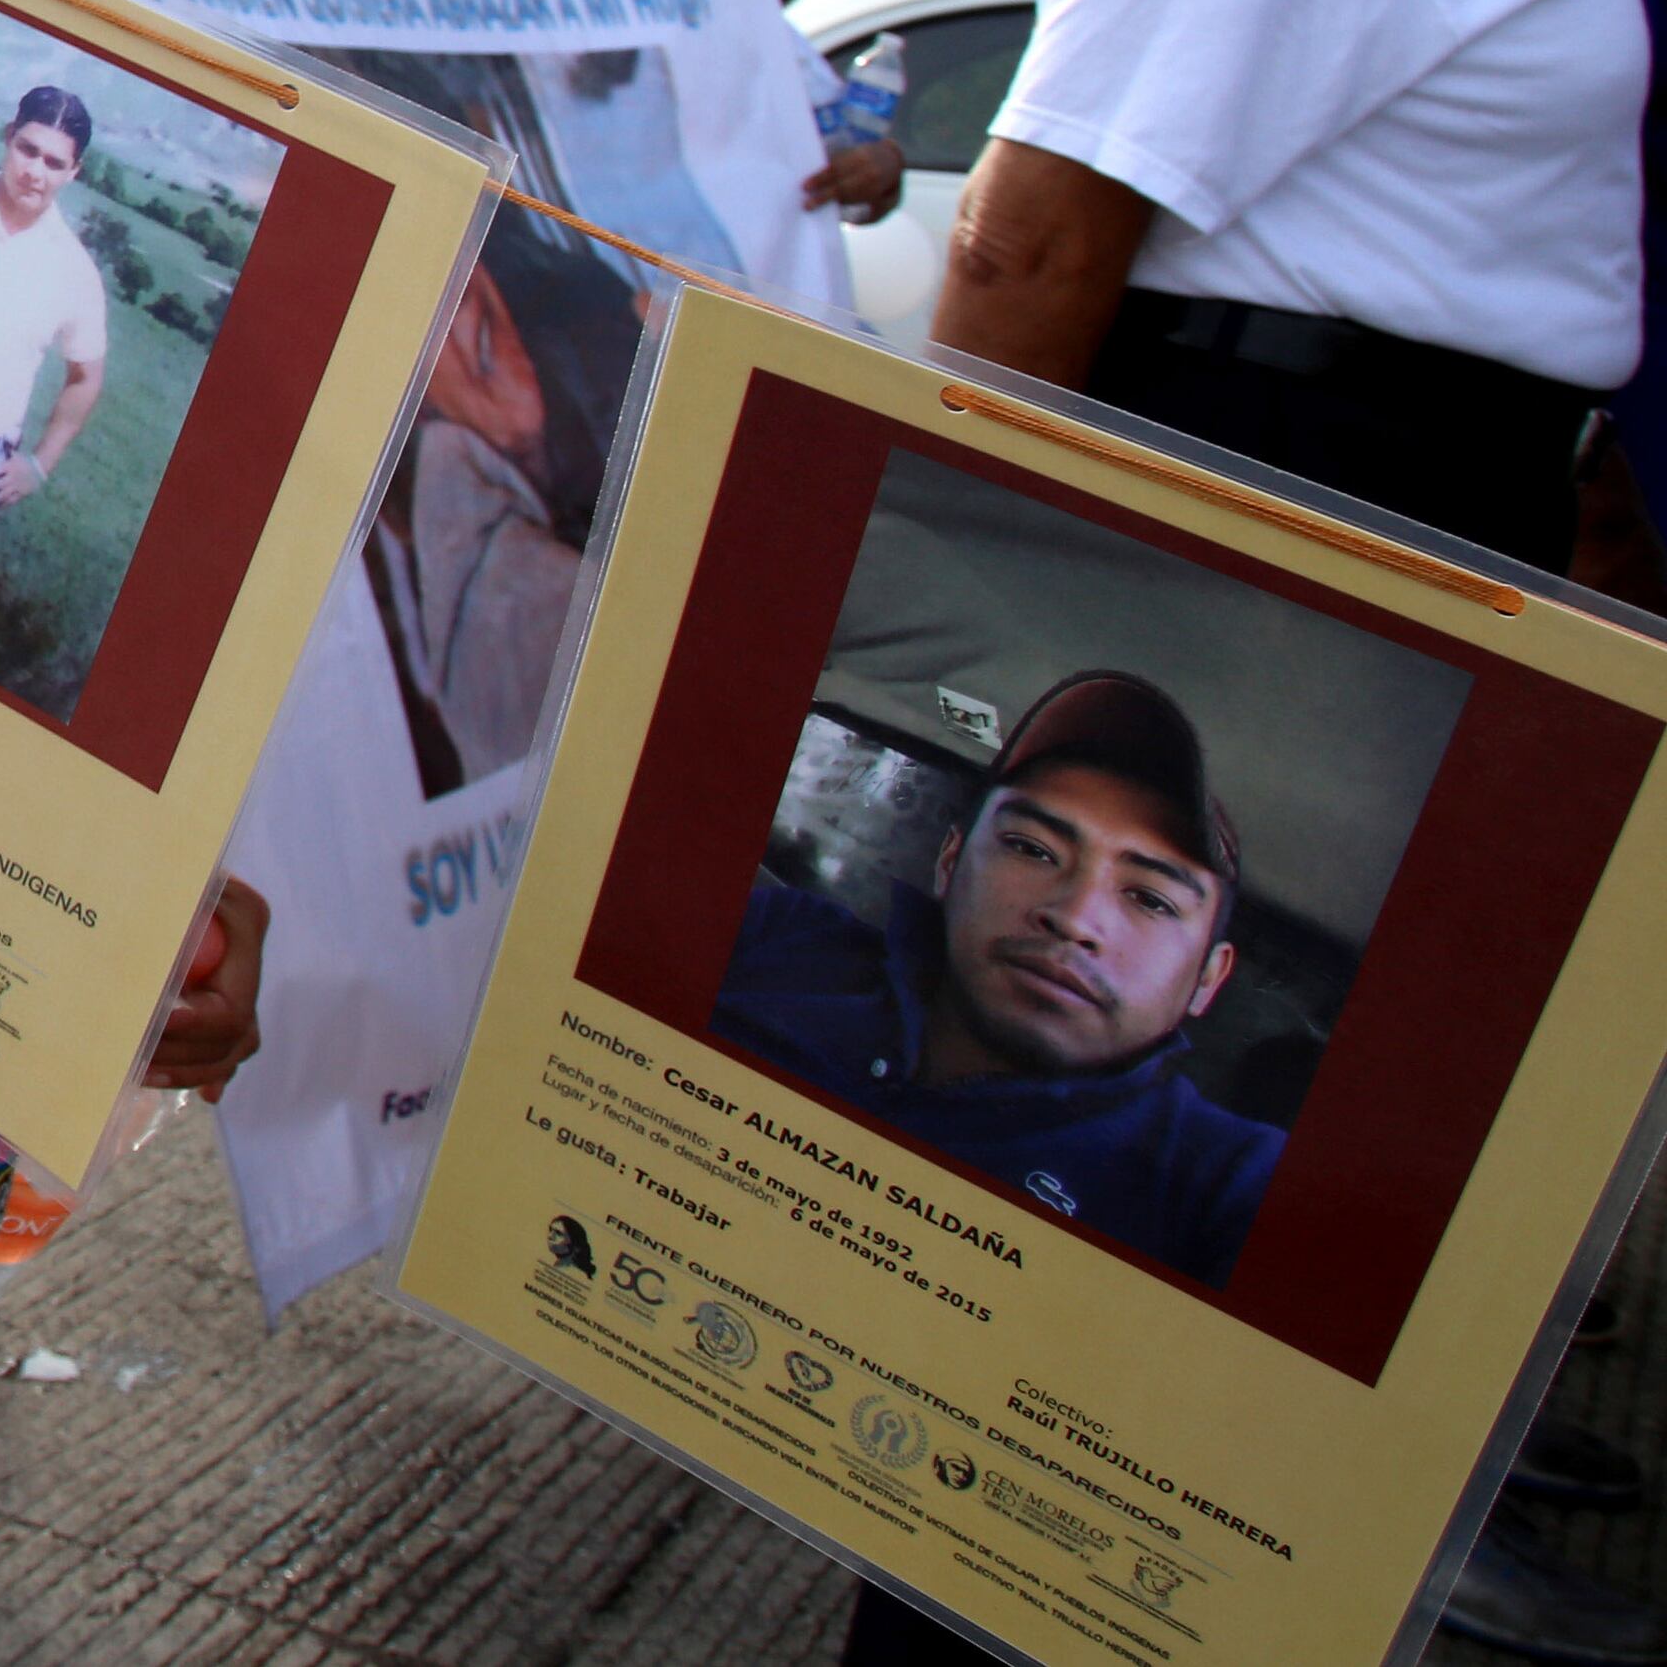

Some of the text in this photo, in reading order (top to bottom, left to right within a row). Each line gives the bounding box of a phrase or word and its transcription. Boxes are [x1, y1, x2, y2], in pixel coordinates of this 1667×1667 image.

[525, 1105, 552, 1131] Le
[634, 1167, 731, 1230] Trabajar
[541, 1070, 587, 1102] Lugar
[602, 1103, 645, 1135] fecha
[649, 1131, 670, 1148] de
[790, 1203, 803, 1221] 6
[808, 1219, 834, 1239] de
[839, 1235, 897, 1272] mayo
[902, 1270, 929, 1290] de
[935, 1284, 991, 1321] 2015
[547, 1053, 912, 1261] Fecha de nacimiento: 3 de mayo de 1992
[560, 1010, 1021, 1269] Nombre: Cesar ALMAZAN SALDAÑA
[605, 1214, 1180, 1540] FRENTE GUERRERO POR NUESTROS DESAPARECIDOS
[1014, 1378, 1113, 1439] Colectivo:
[1006, 1395, 1291, 1561] Raúl TRUJILLO HERRERA
[1025, 1491, 1116, 1549] MORELOS
